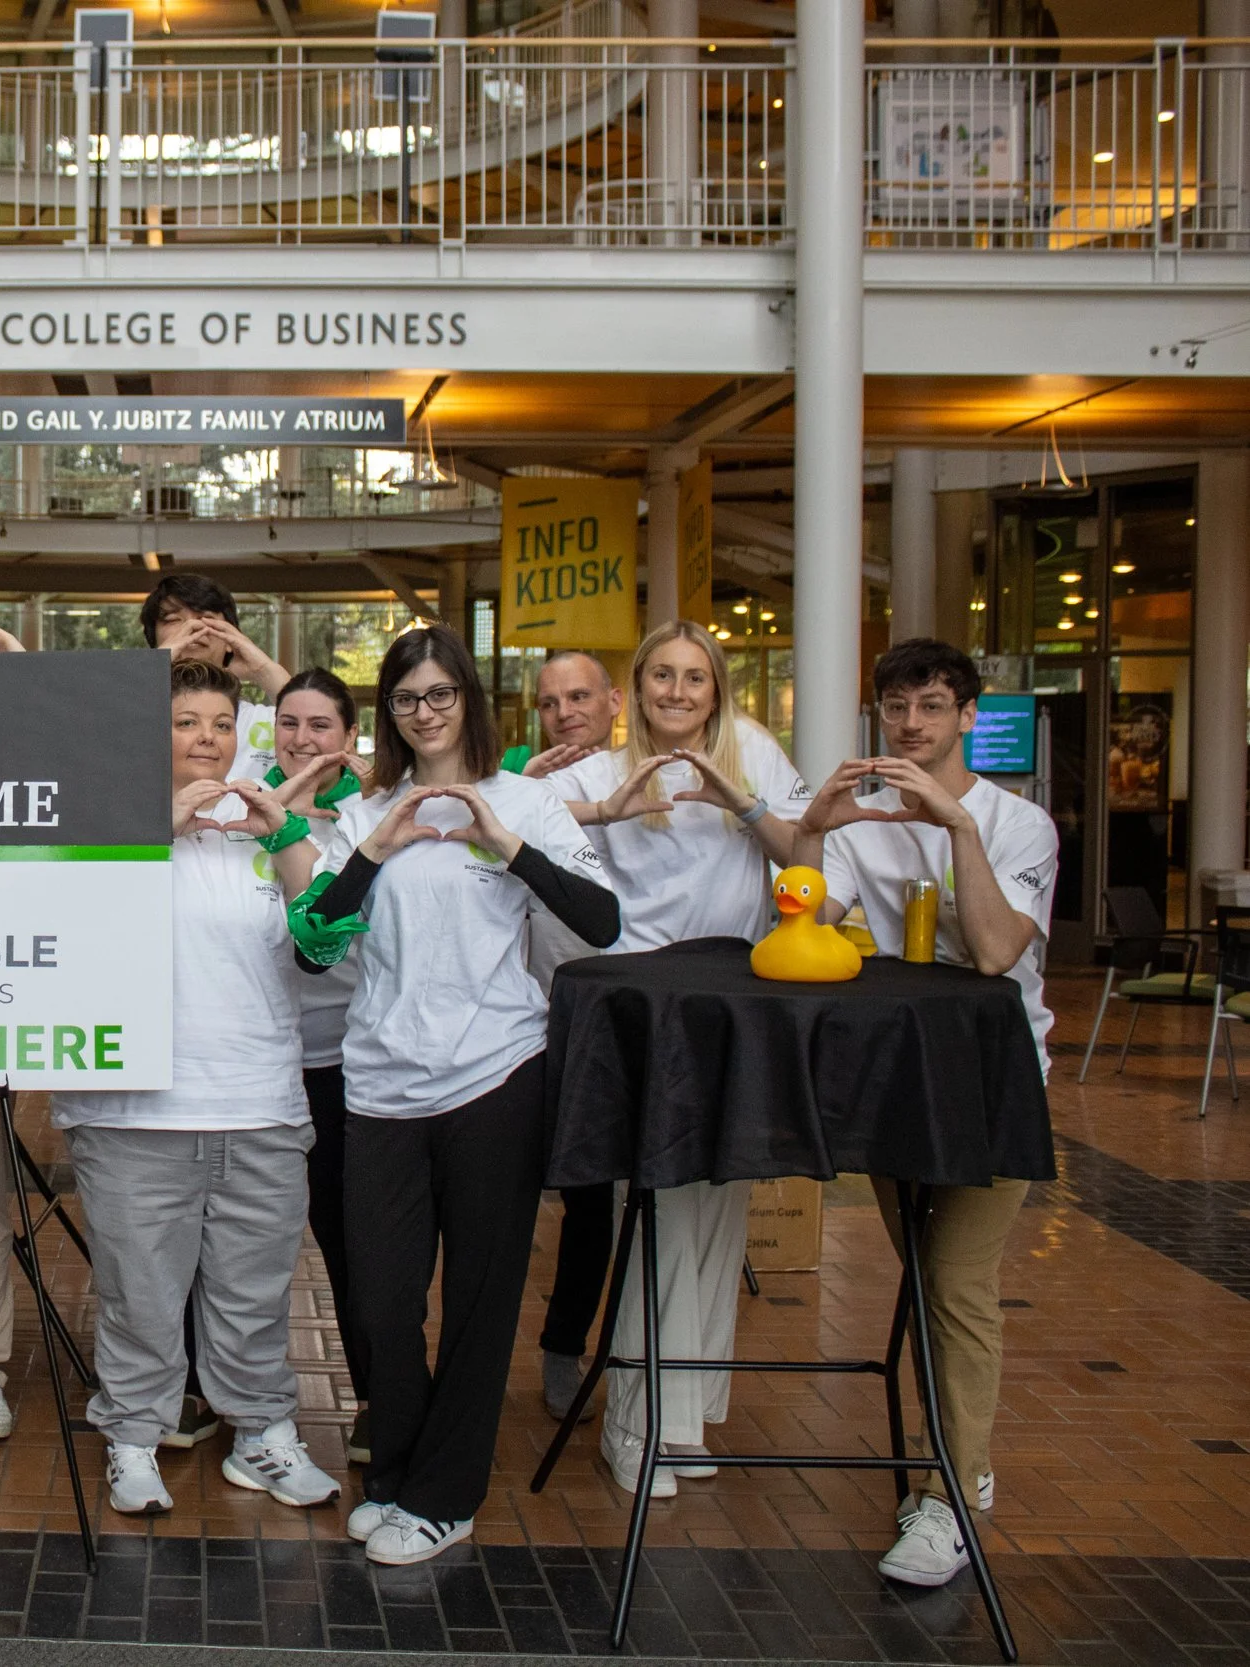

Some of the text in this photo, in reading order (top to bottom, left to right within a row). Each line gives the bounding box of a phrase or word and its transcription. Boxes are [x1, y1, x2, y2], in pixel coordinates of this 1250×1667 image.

[1, 313, 176, 346] COLLEGE
[200, 313, 252, 346] OF
[277, 312, 468, 346] BUSINESS
[27, 410, 81, 430] GAIL
[89, 410, 108, 431] Y.
[112, 410, 192, 430] JUBITZ
[201, 410, 285, 430] FAMILY
[293, 410, 386, 431] ATRIUM
[516, 516, 599, 564] INFO
[516, 555, 623, 607] KIOSK
[749, 1207, 804, 1219] dium Cups
